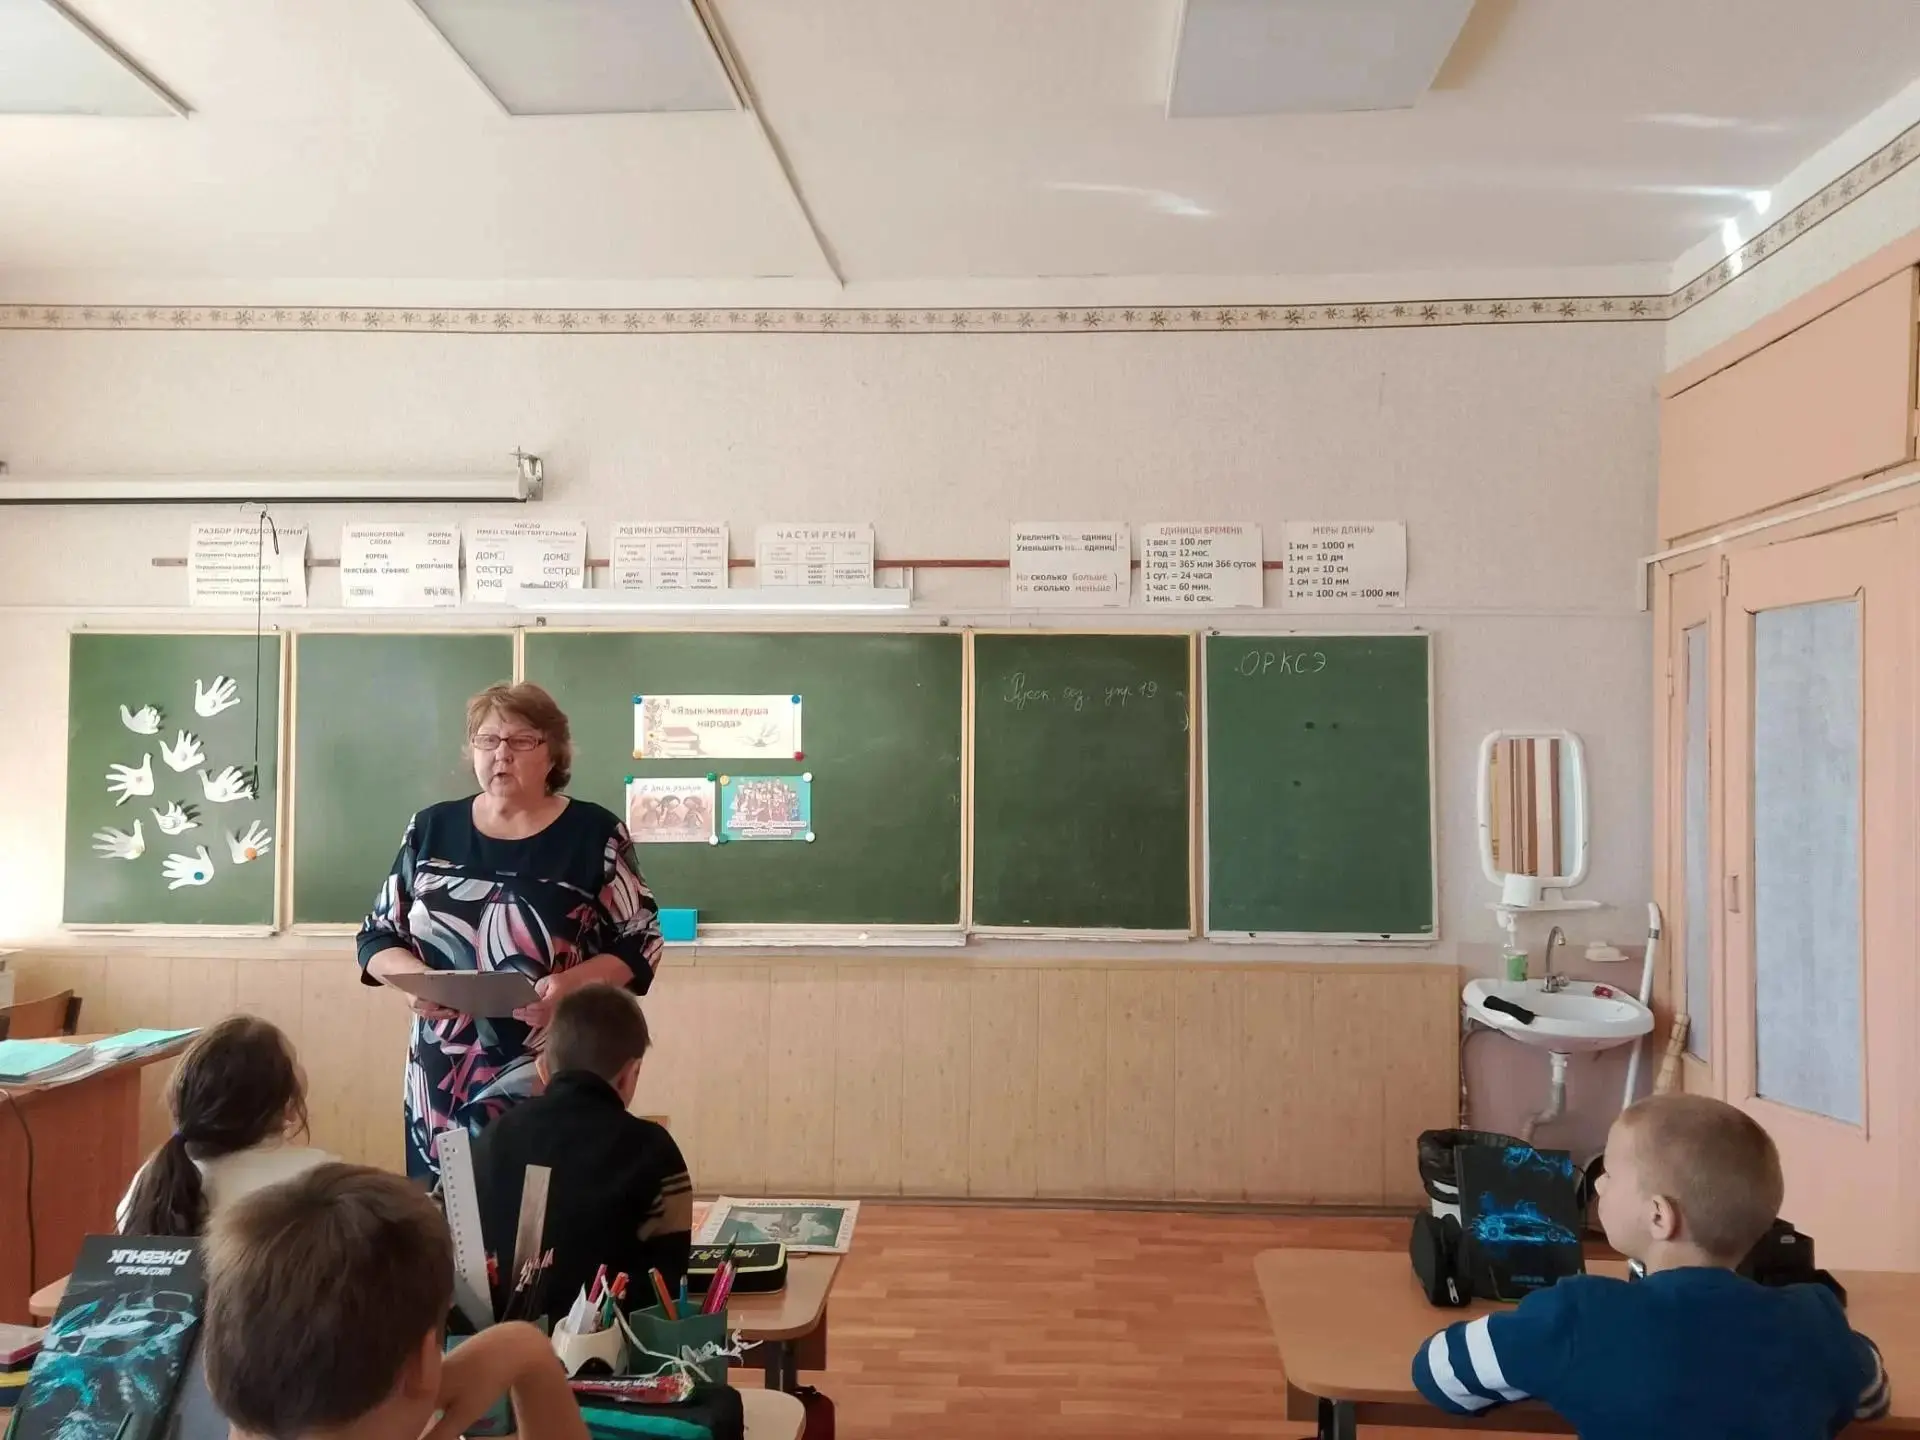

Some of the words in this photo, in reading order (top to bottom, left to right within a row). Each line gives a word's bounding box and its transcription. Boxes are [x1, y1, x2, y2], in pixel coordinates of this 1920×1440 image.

[776, 530, 819, 539] ЧАСТИ
[821, 530, 856, 539] РЕЧИ
[1160, 526, 1202, 536] ЕДИНИЦЫ
[1312, 526, 1339, 535] МЕРЫ
[1341, 525, 1375, 534] ДЛИНЫ
[1016, 533, 1060, 541] Увеличить
[1081, 533, 1112, 542] единиц
[1179, 538, 1195, 546] 100
[1016, 544, 1063, 552] Уменьшить
[1084, 544, 1115, 552] единиц
[1322, 541, 1345, 549] 1000
[1317, 553, 1328, 561] 10
[1153, 561, 1168, 569] год
[1179, 560, 1195, 568] 365
[1215, 560, 1231, 568] 366
[1233, 561, 1257, 569] суток
[1323, 565, 1334, 573] 10
[476, 565, 514, 576] сестра
[1180, 571, 1191, 579] 24
[1072, 572, 1108, 581] больше
[1322, 577, 1333, 585] 10
[477, 579, 503, 589] река
[1317, 589, 1334, 597] 100
[1360, 589, 1383, 597] 1000
[1146, 594, 1150, 602] 1
[1183, 594, 1194, 602] 60
[1240, 650, 1326, 676] ОРКСЭ
[741, 707, 769, 717] душа
[696, 720, 742, 728] народа»
[106, 1248, 192, 1266] ДНЕВНИК
